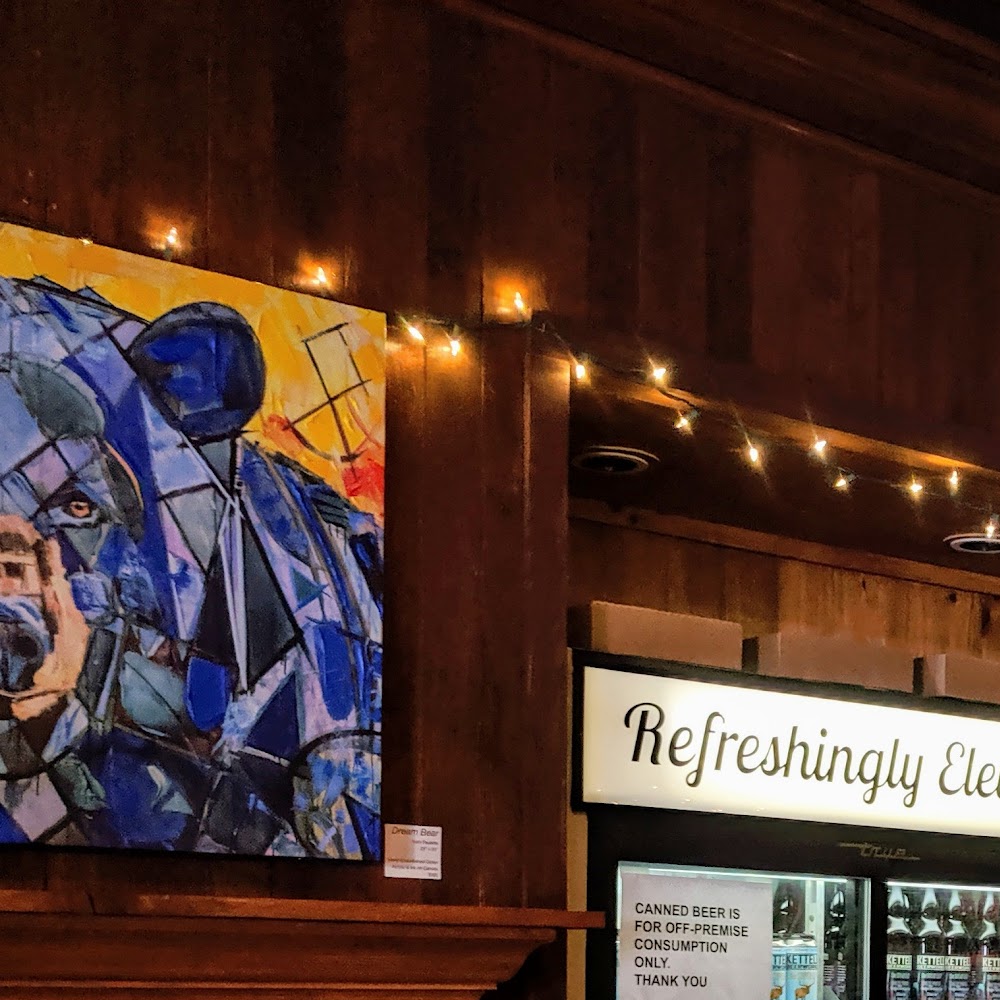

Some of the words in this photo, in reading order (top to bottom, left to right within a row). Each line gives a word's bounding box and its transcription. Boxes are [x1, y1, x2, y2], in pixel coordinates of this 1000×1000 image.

[624, 702, 924, 808] Refreshingly
[420, 828, 439, 837] Bear
[635, 902, 689, 917] CANNED
[692, 906, 726, 919] BEER
[729, 908, 740, 920] IS
[634, 920, 662, 933] FOR
[665, 922, 749, 937] OFF-PREMISE
[634, 938, 728, 953] CONSUMPTION
[634, 956, 671, 969] ONLY.
[634, 973, 679, 987] THANK
[681, 975, 708, 987] YOU
